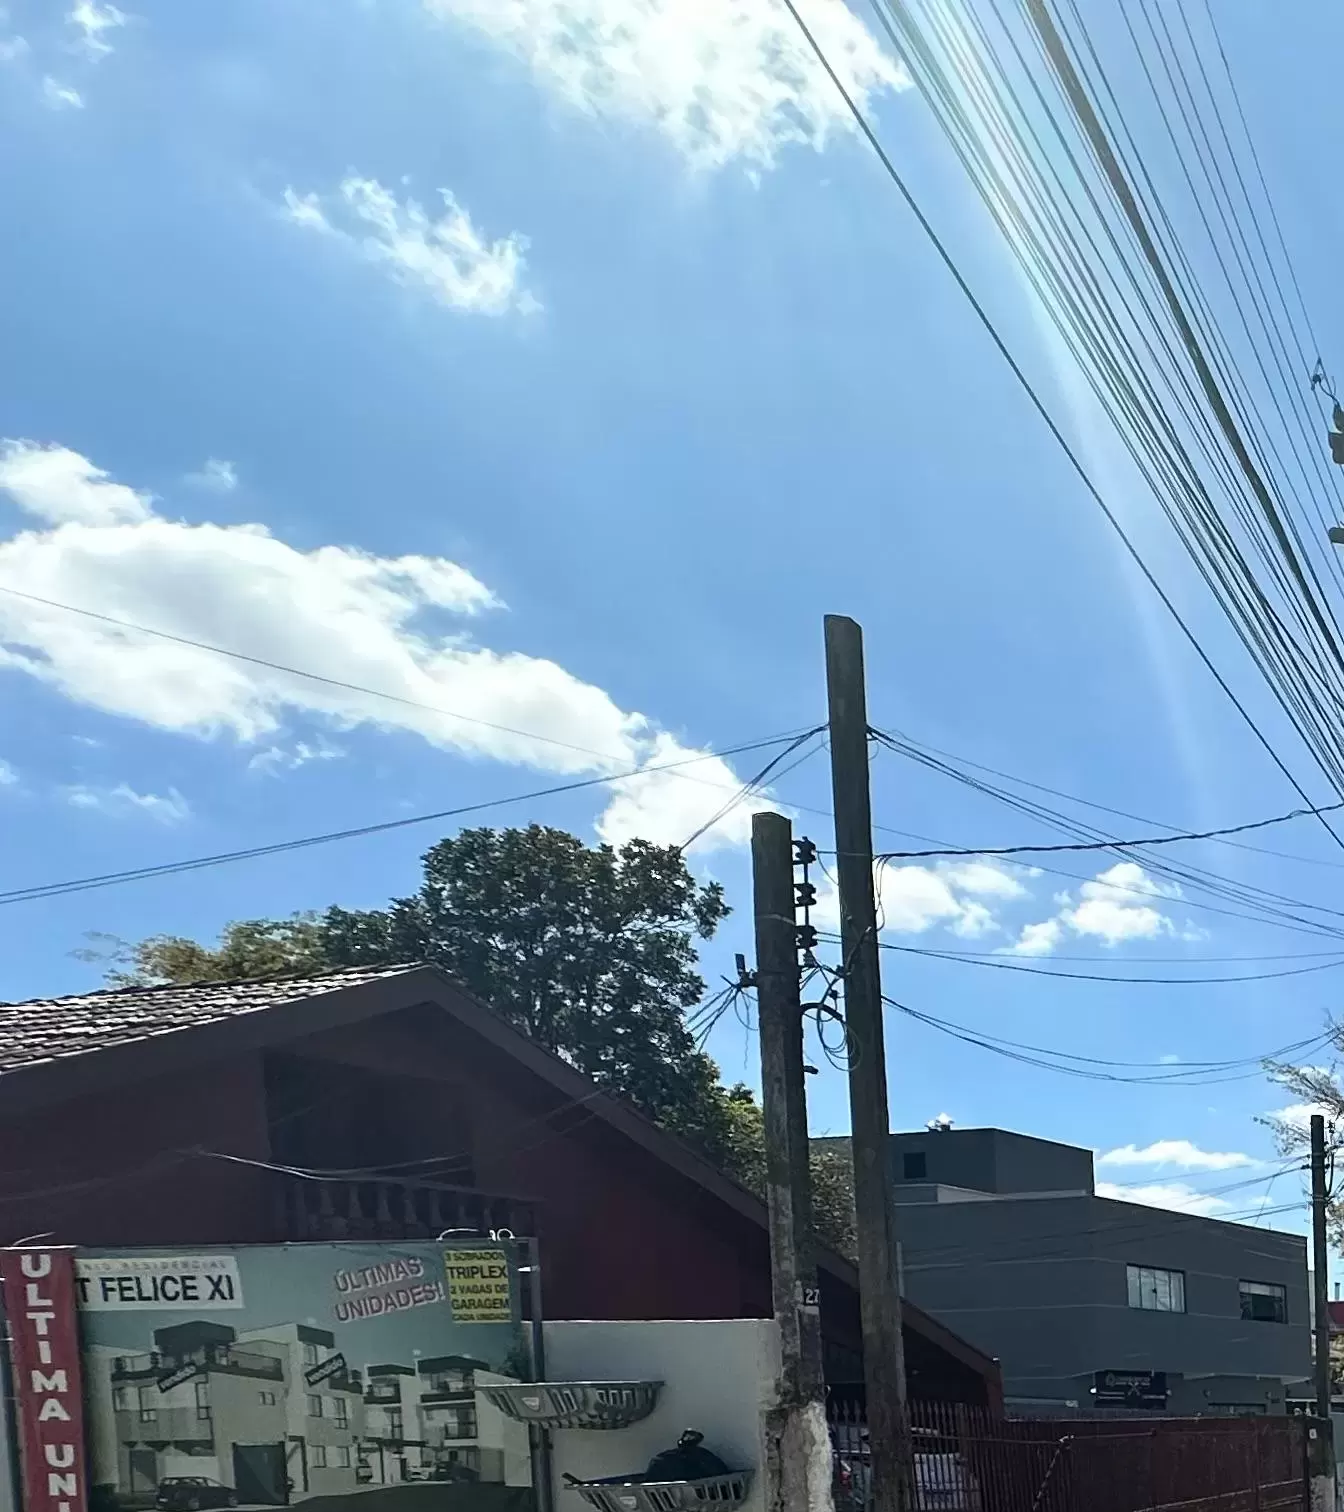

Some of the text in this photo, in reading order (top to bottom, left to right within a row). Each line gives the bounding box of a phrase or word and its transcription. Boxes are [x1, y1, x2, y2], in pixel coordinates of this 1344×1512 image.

[447, 1265, 508, 1280] TRIPLEX
[99, 1275, 199, 1302] FELICE
[204, 1274, 235, 1301] XI
[459, 1284, 493, 1294] VAGAS
[495, 1284, 508, 1294] DE
[334, 1281, 446, 1322] UNIDADES!
[452, 1298, 509, 1310] GARAGEM
[20, 1254, 71, 1422] ULTIMA
